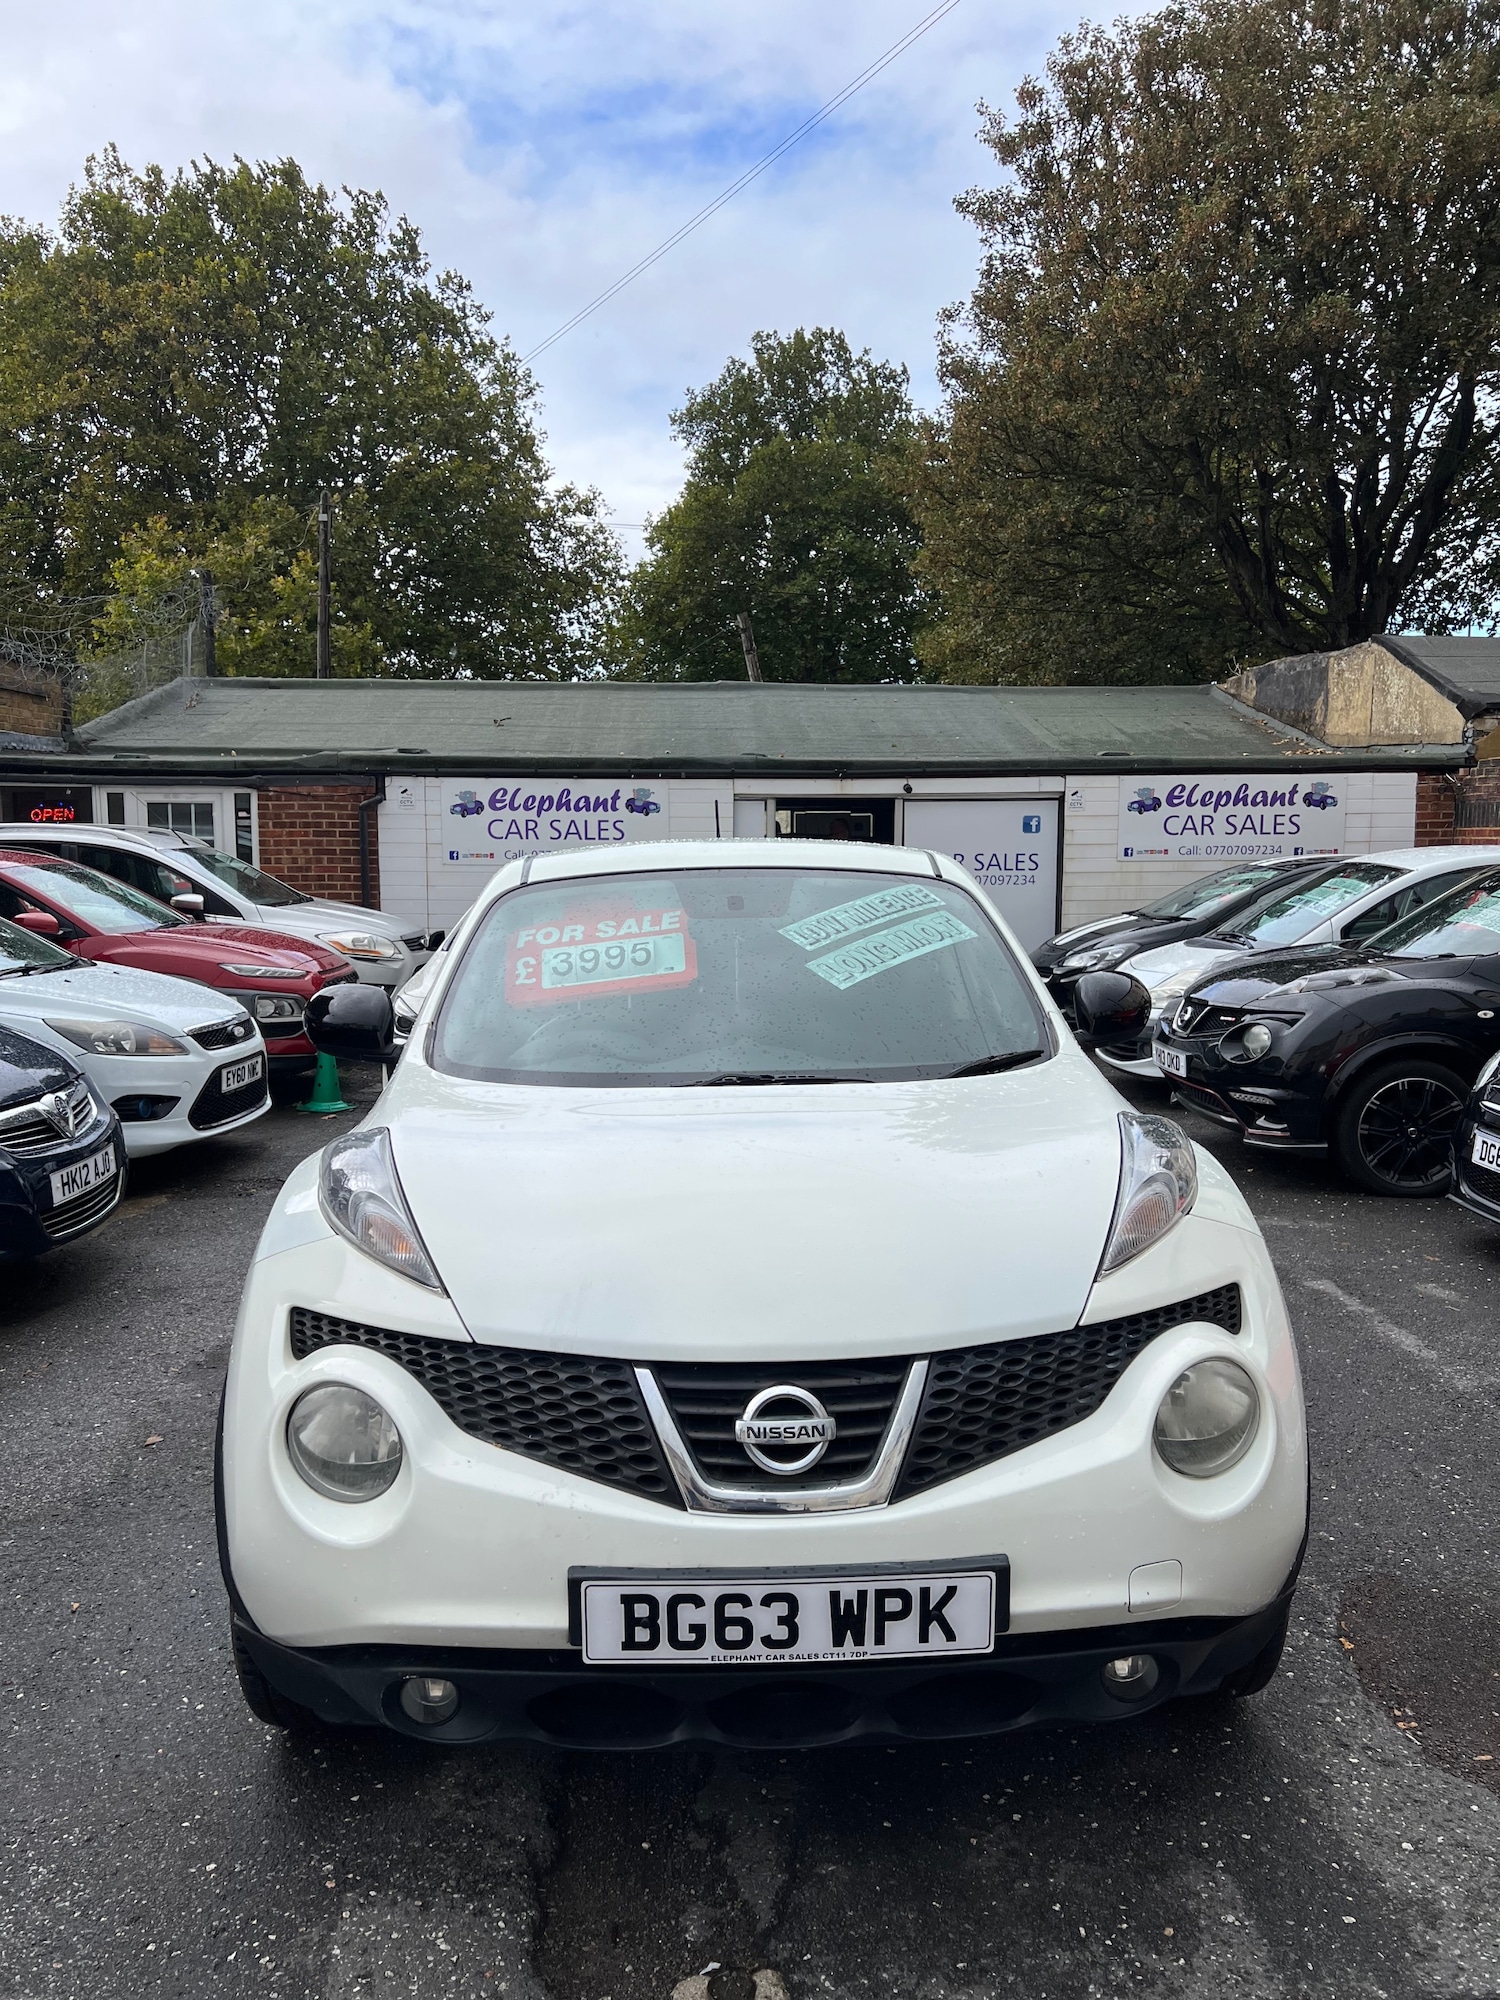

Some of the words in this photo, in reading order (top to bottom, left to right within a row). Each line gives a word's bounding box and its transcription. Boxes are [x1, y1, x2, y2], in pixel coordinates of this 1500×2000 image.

[488, 787, 621, 818] Elephant
[1165, 783, 1300, 813] Elephant
[30, 808, 75, 822] OPEN
[1163, 814, 1215, 836] CAR
[1225, 814, 1301, 836] SALES
[487, 819, 540, 840] CAR
[549, 819, 625, 841] SALES
[974, 853, 1039, 871] SALES
[1178, 845, 1201, 856] Call:
[1205, 845, 1282, 856] 07707097234
[516, 925, 585, 948] FOR
[595, 911, 682, 938] SALE
[788, 914, 849, 947] LOW
[841, 887, 938, 926] MILEAGE
[515, 957, 537, 985] £
[552, 941, 652, 977] 3995
[816, 938, 900, 982] LONG
[226, 1065, 246, 1087] EY60
[61, 1163, 91, 1197] HK12
[746, 1424, 826, 1439] NISSAN
[619, 1591, 800, 1652] BG63
[829, 1585, 958, 1648] WPK
[711, 1654, 763, 1662] ELEPHANT
[788, 1653, 819, 1661] SALES
